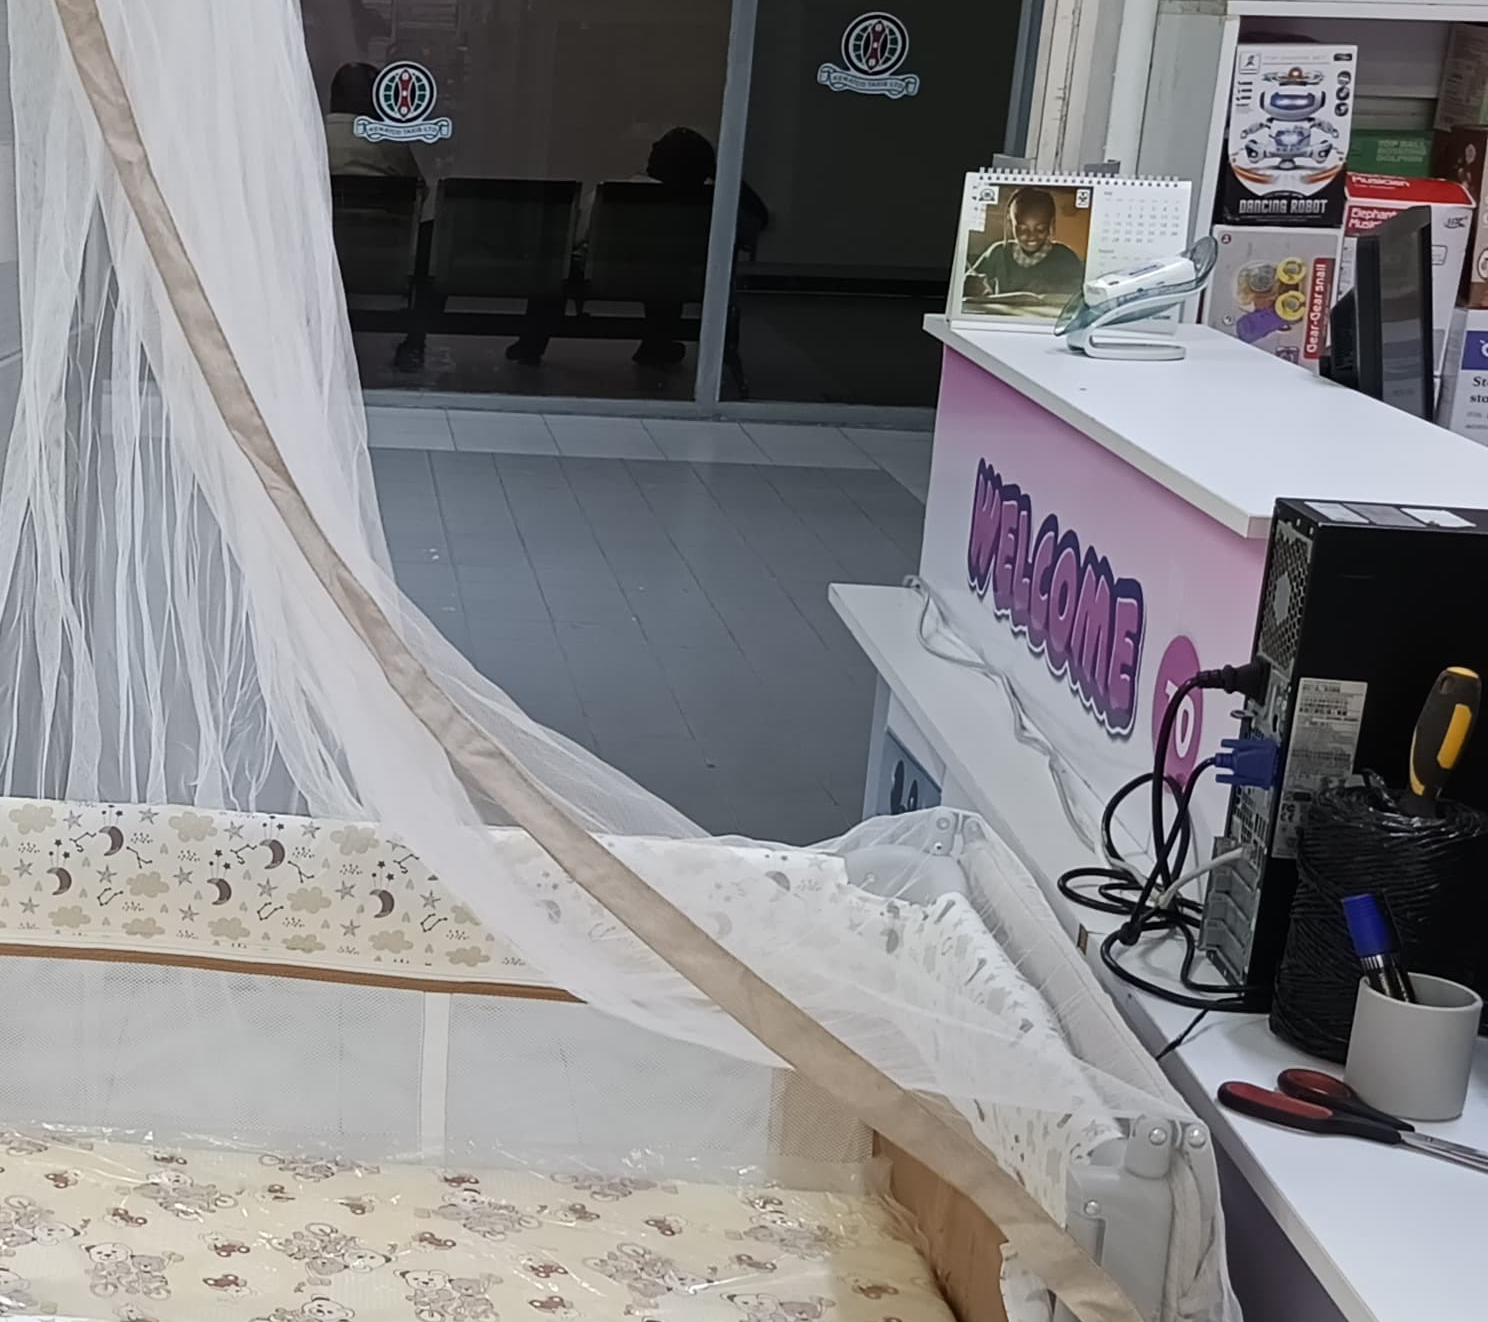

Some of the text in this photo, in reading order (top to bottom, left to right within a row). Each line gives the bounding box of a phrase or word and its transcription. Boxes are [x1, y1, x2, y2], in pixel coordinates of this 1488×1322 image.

[1290, 200, 1328, 213] ROBOT
[1306, 264, 1327, 353] Gear-Gear snail
[968, 458, 1146, 735] WELCOME
